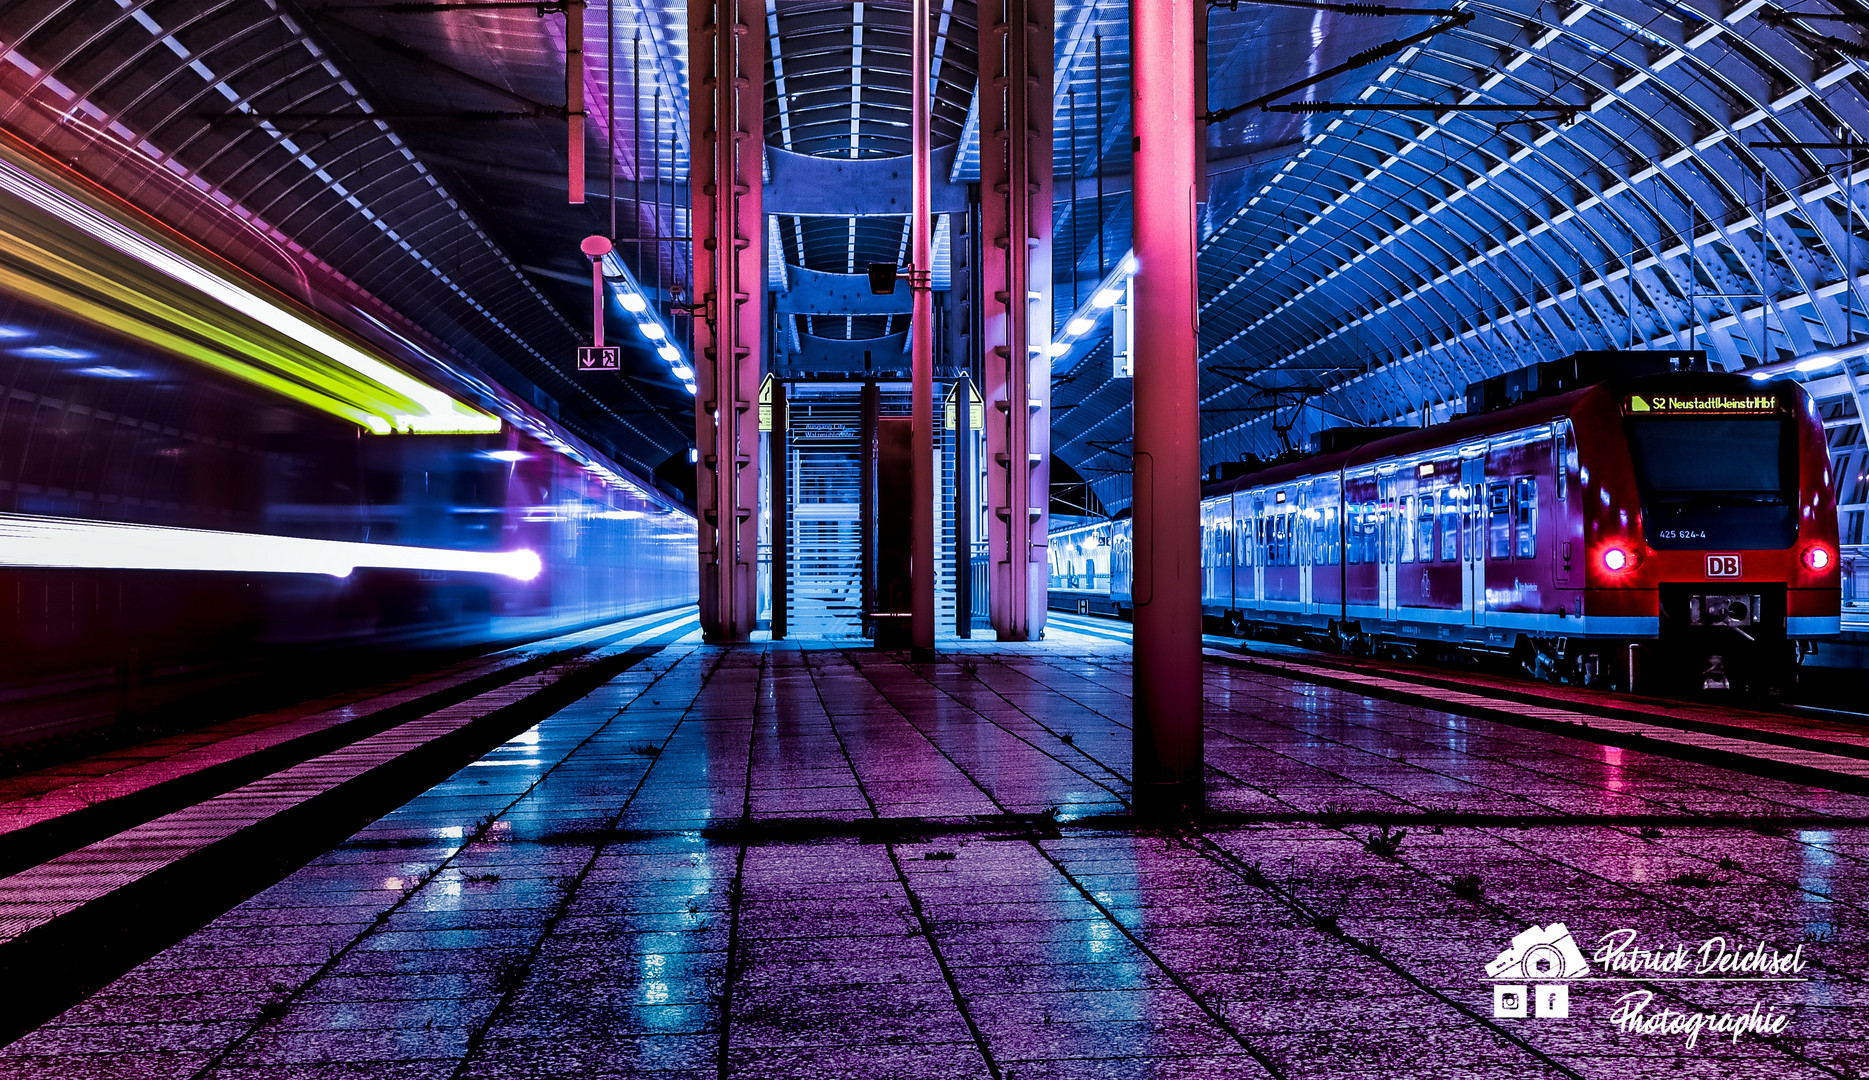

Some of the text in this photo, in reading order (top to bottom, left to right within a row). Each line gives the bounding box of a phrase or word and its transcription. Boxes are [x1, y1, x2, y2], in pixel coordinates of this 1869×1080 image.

[1652, 397, 1666, 410] S2
[1659, 530, 1706, 539] 425 624-4
[1709, 558, 1738, 575] DB
